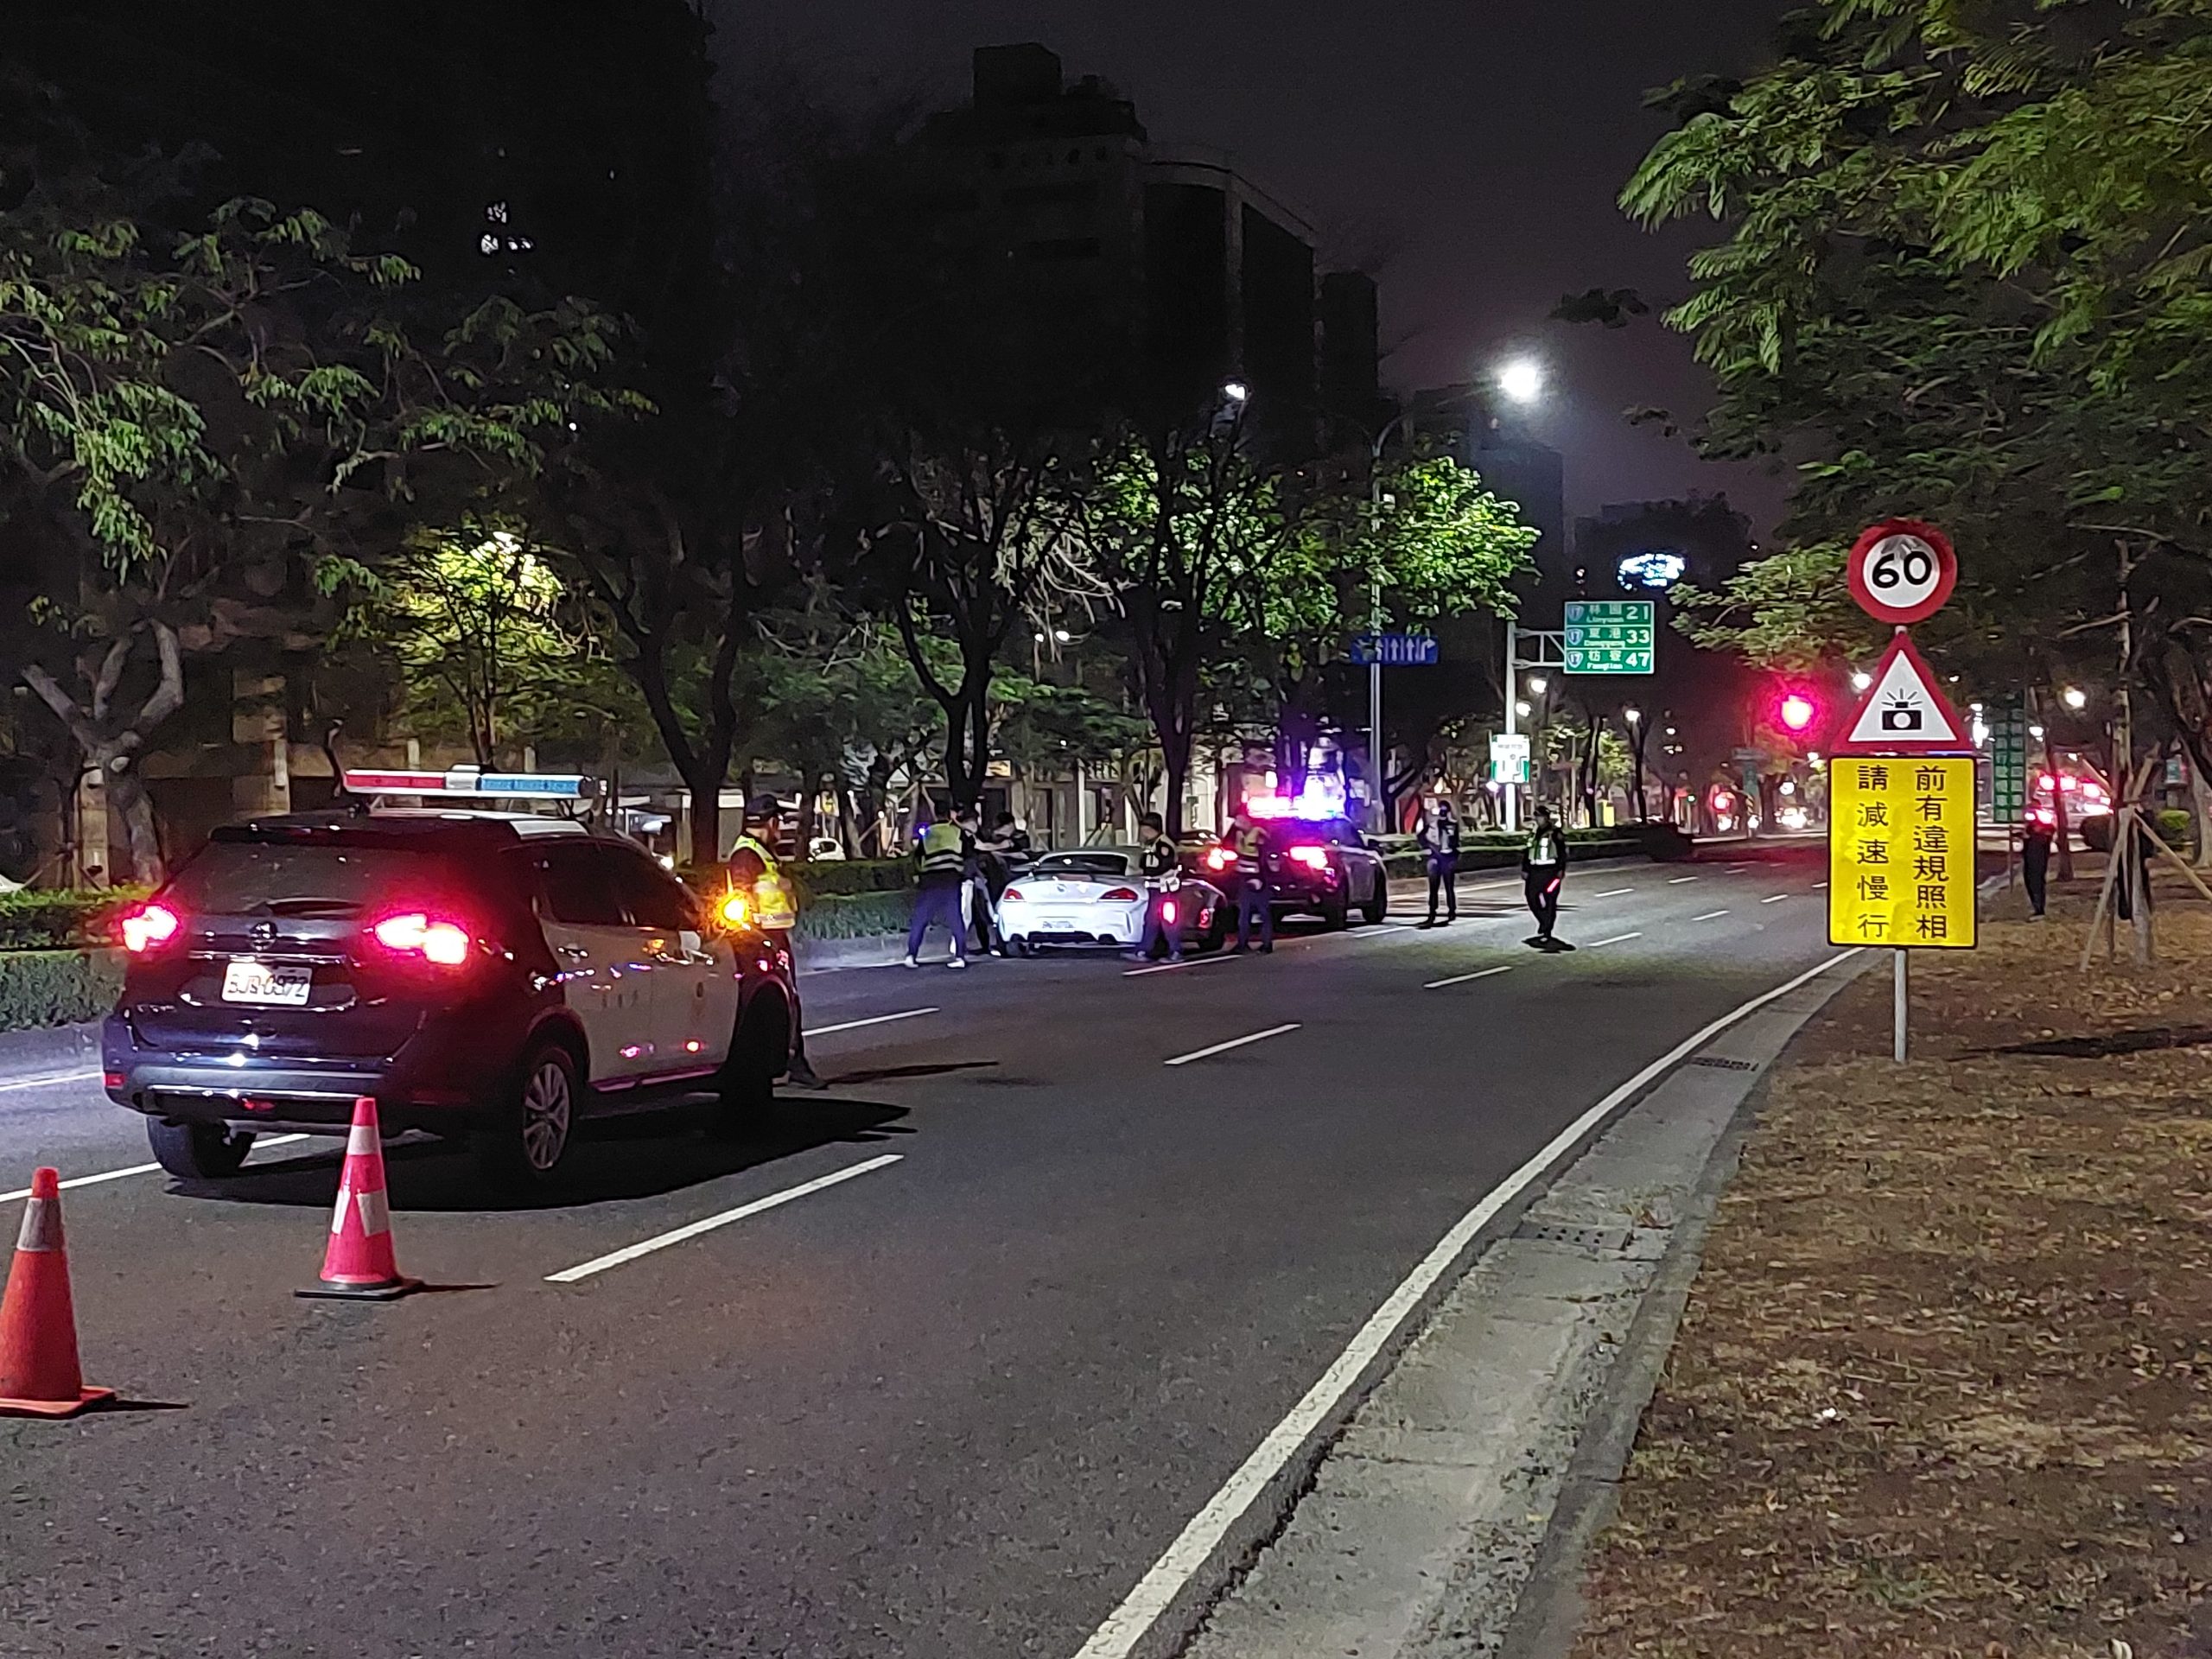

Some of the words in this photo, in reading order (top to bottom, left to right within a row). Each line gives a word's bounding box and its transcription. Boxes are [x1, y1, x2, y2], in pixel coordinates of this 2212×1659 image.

[1872, 550, 1933, 589] 60
[1625, 606, 1649, 620] 21
[1625, 629, 1650, 645] 33
[1625, 652, 1650, 668] 47
[1856, 764, 1890, 938] 請減速慢行
[1912, 765, 1950, 939] 前有違規照相
